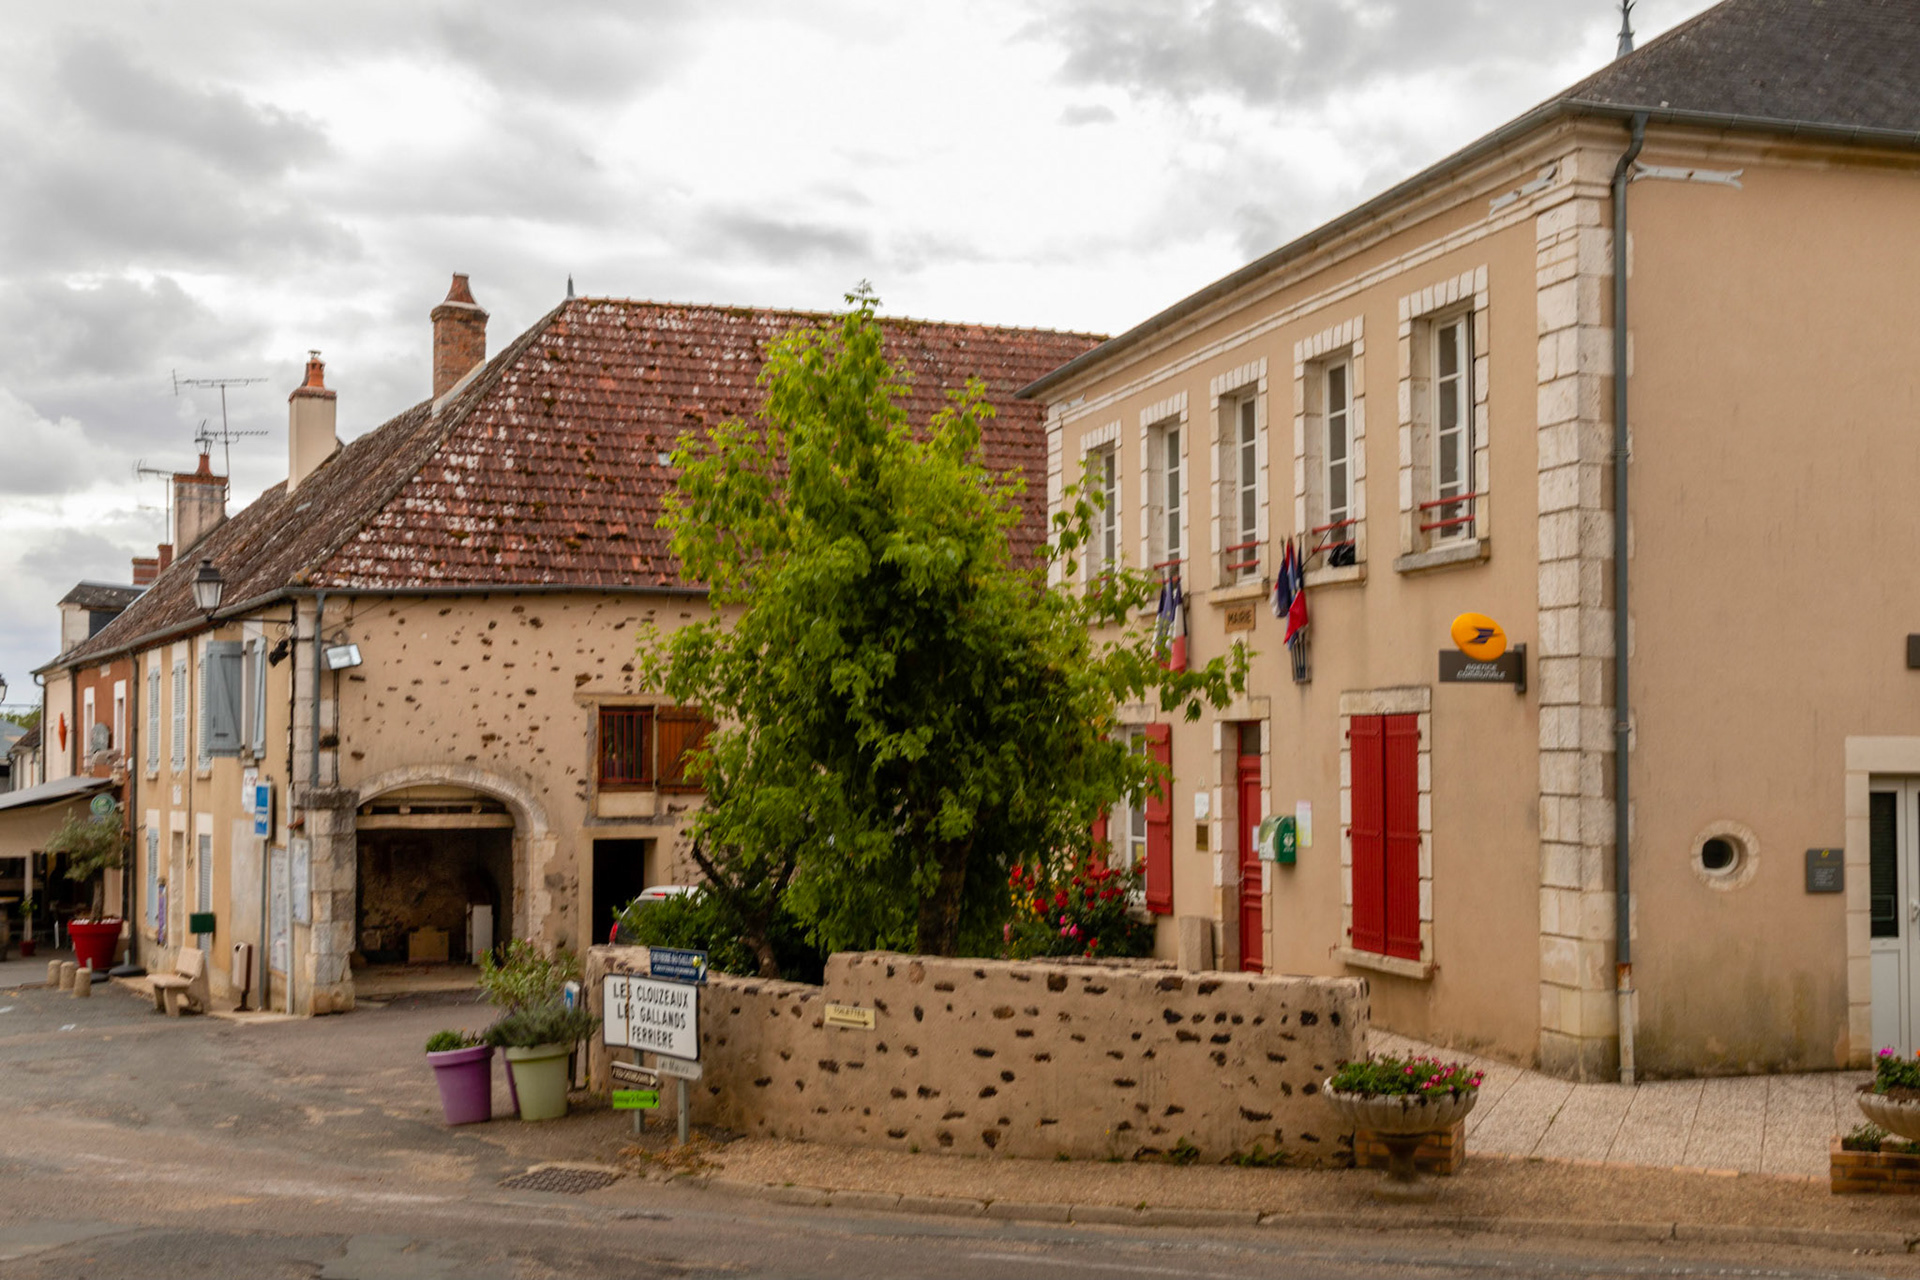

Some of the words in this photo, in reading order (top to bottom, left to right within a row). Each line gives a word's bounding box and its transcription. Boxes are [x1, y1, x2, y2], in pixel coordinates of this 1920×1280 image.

[613, 982, 632, 999] LES
[636, 985, 689, 1009] CLOUZEAUX
[617, 1002, 635, 1020] LES
[640, 1006, 686, 1031] GALLANDS
